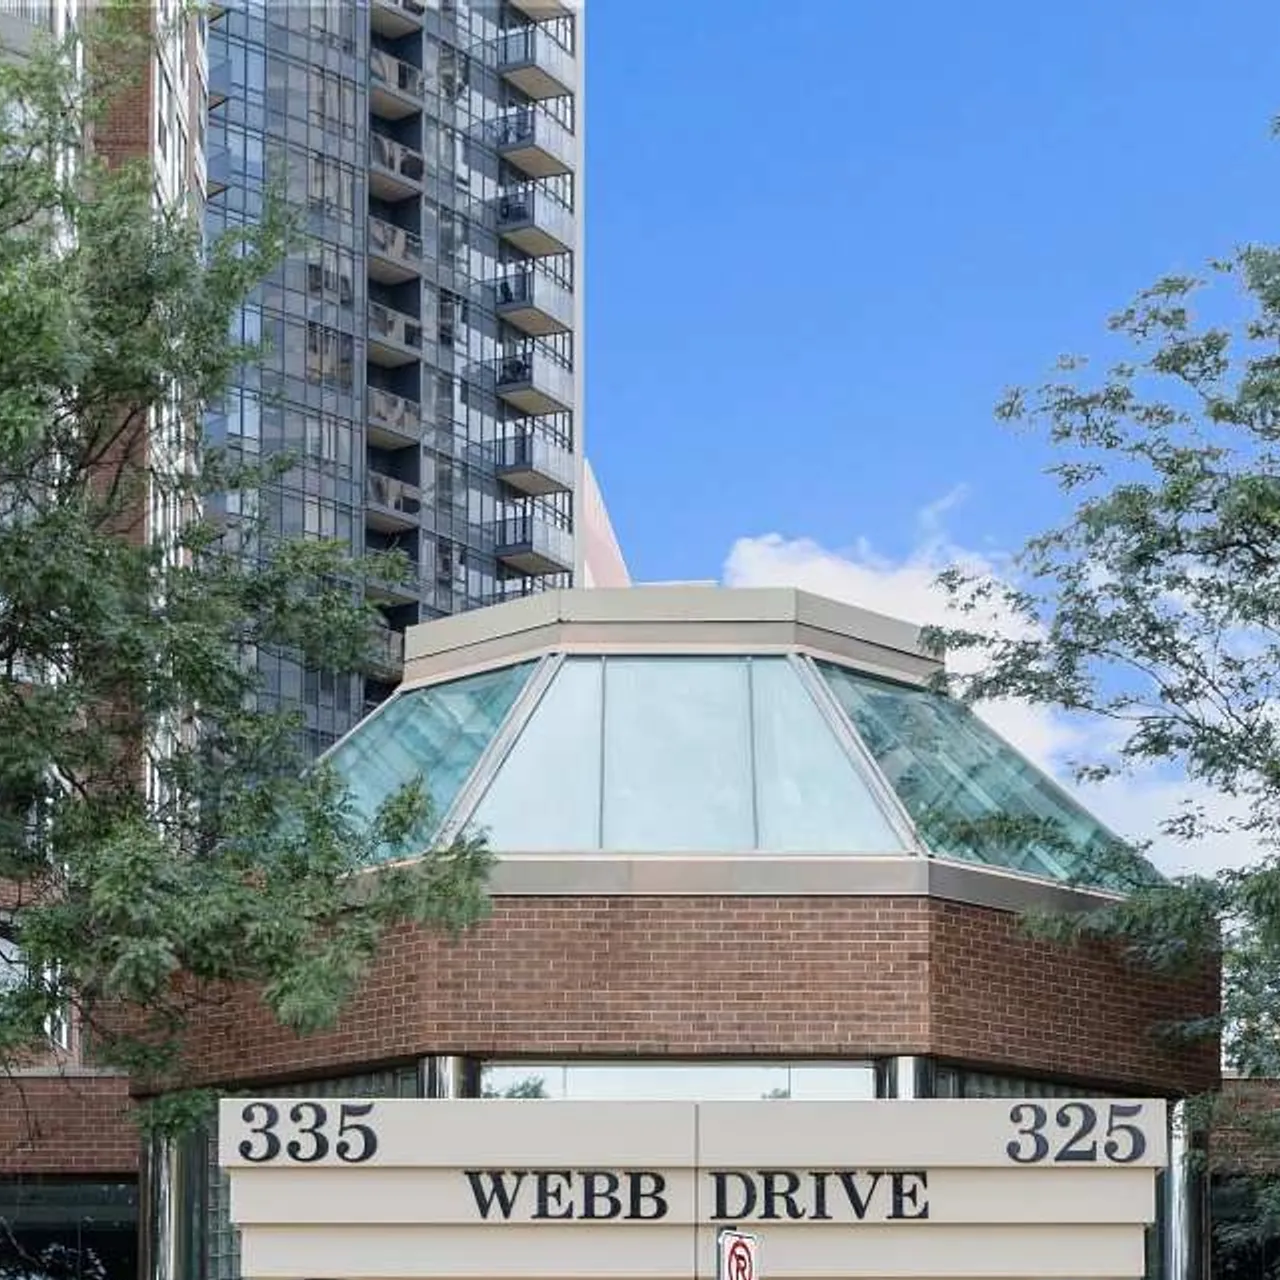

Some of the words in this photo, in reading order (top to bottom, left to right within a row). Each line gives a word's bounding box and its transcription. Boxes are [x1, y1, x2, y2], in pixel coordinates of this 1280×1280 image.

[238, 1102, 379, 1163] 335
[1006, 1102, 1148, 1164] 325
[463, 1168, 669, 1220] WEBB
[708, 1169, 930, 1220] DRIVE
